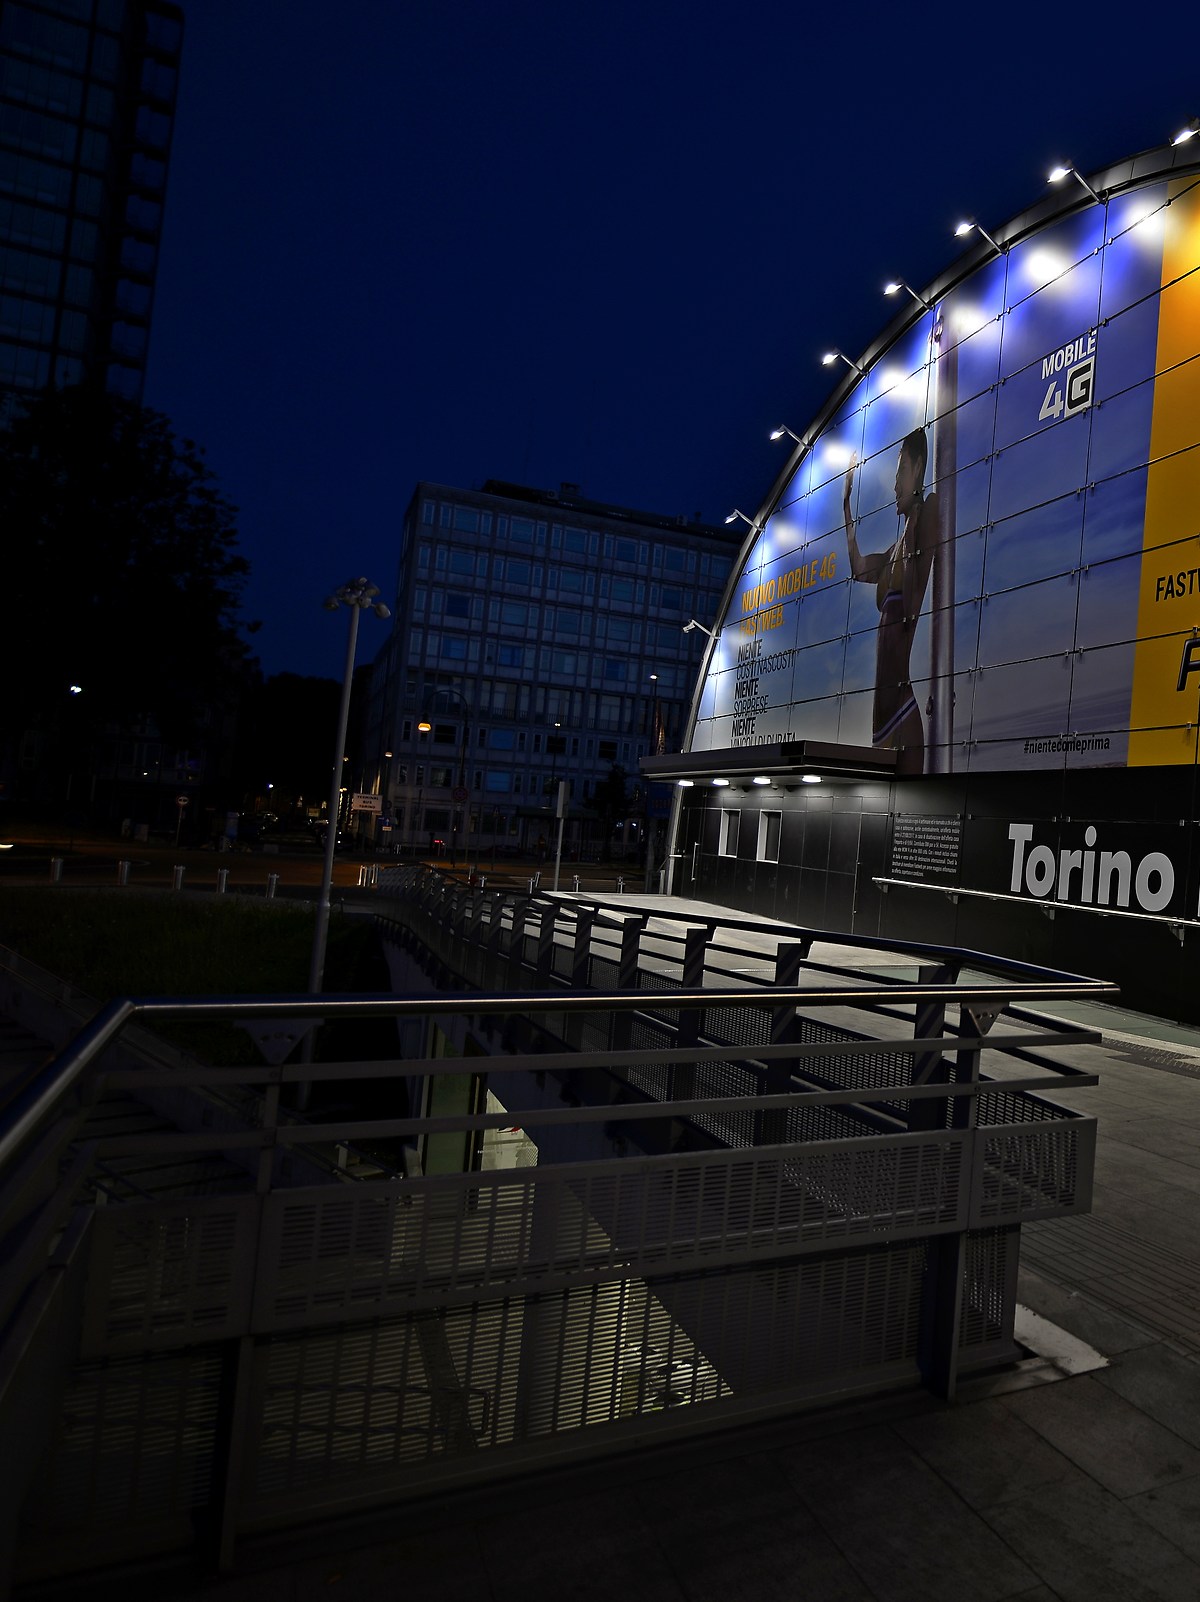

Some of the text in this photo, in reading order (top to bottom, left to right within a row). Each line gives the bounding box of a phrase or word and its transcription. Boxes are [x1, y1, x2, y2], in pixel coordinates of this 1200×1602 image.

[1042, 329, 1098, 380] MOBILE
[1039, 356, 1095, 421] 4G
[742, 552, 836, 613] NUOVO MOBILE 4G
[737, 639, 763, 663] NIENTE
[734, 678, 759, 700] NIENTE
[734, 695, 769, 719] SORPRESE
[731, 717, 756, 738] NIENTE
[1024, 734, 1110, 755] #nientecomeprima
[1008, 823, 1174, 911] Torino
